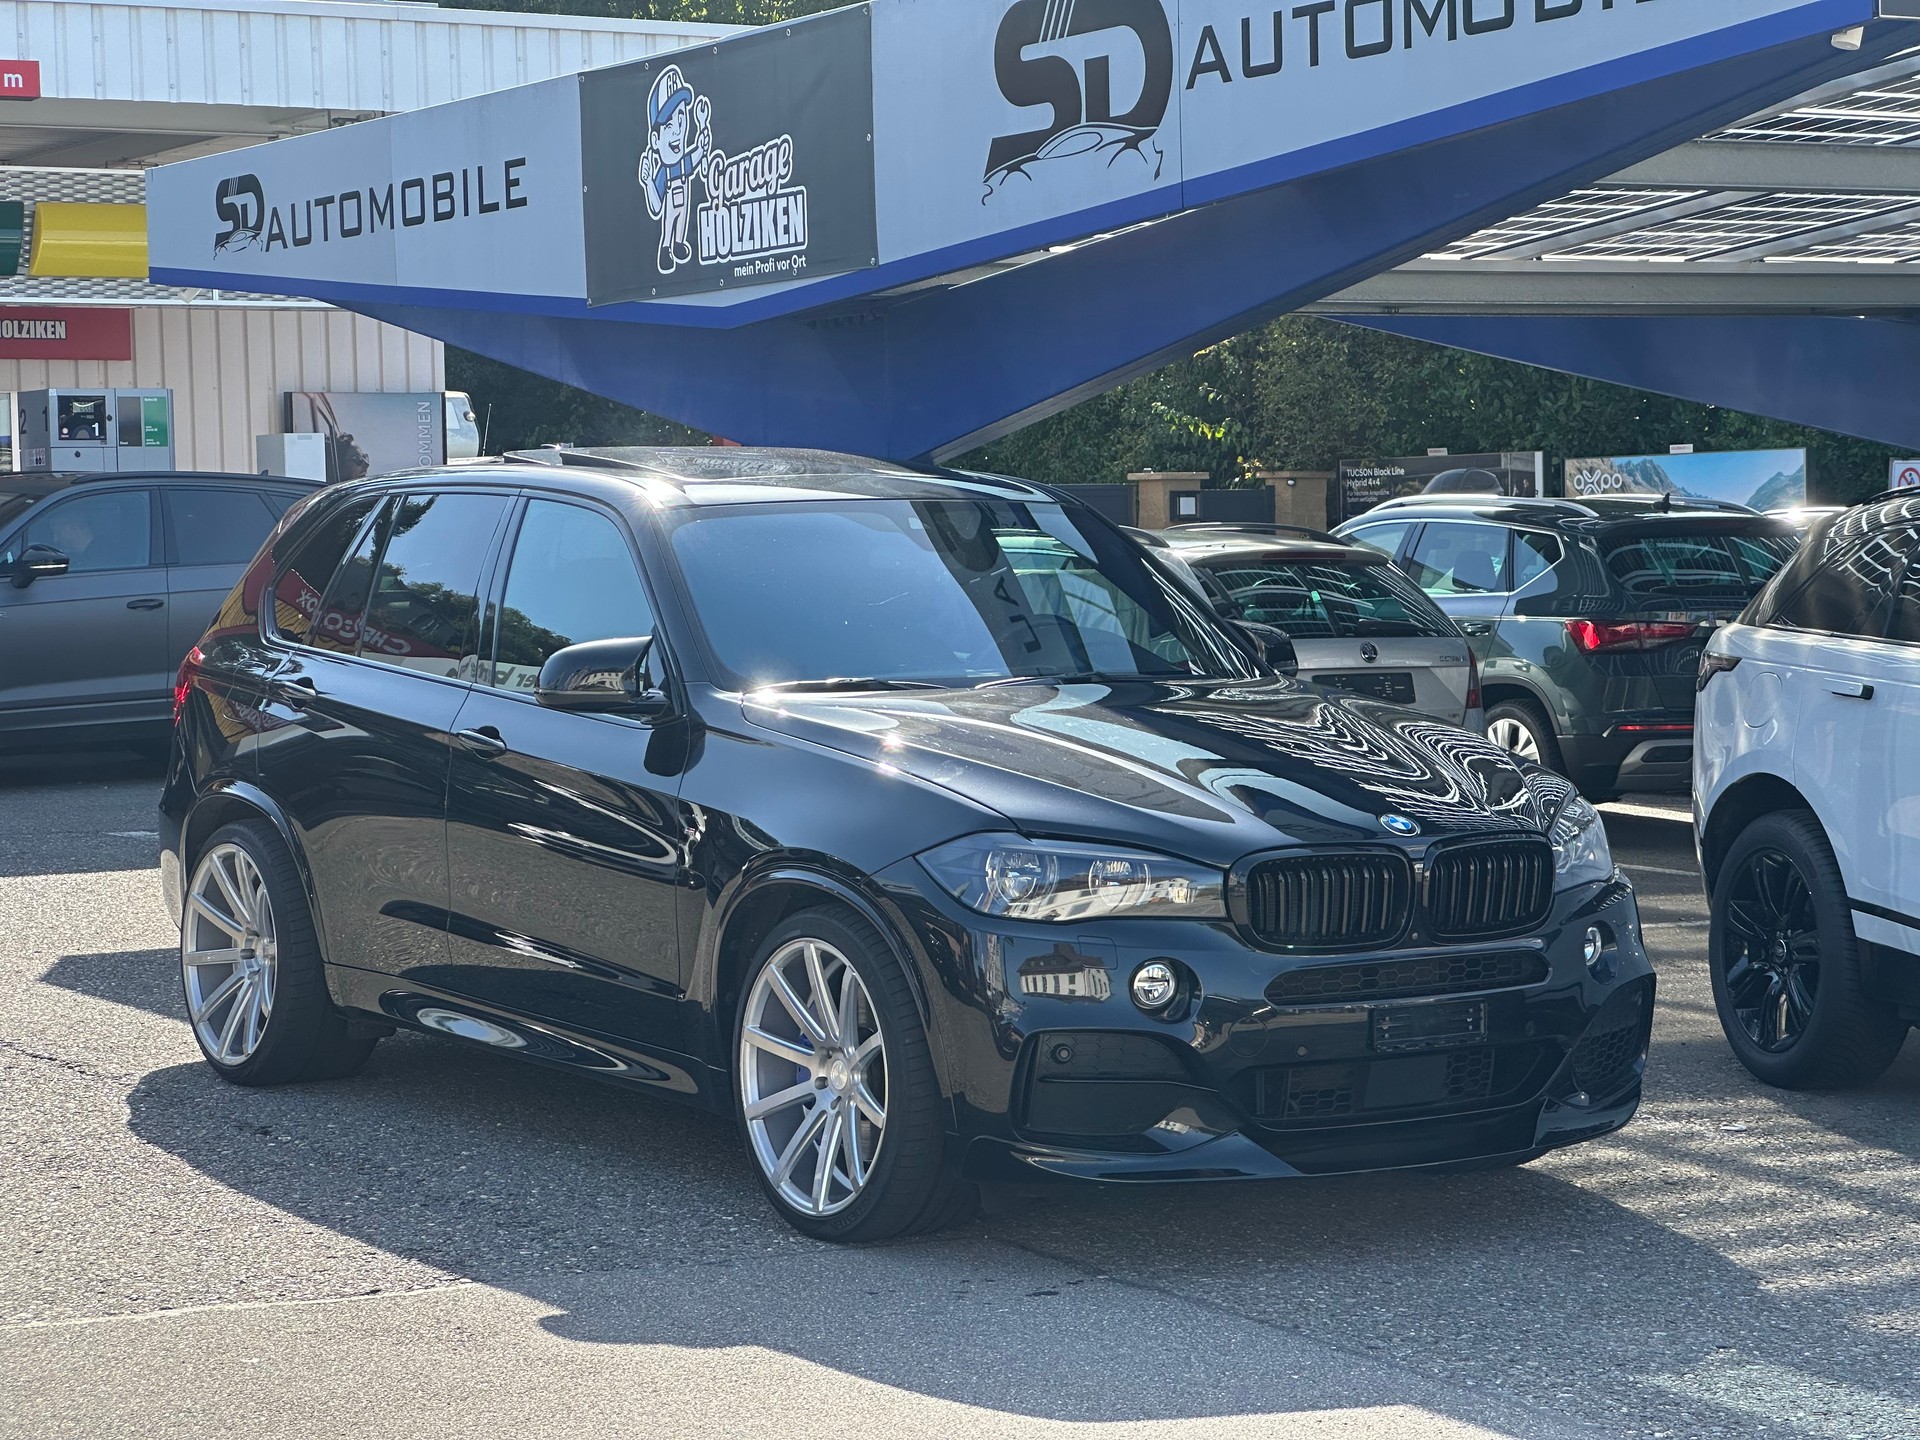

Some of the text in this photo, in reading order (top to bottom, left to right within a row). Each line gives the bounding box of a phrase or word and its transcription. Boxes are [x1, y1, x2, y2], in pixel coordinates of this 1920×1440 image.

[707, 141, 791, 212] Garage
[265, 157, 528, 252] AUTOMOBILE
[700, 193, 805, 258] HOLZIKEN
[734, 255, 807, 277] mein Profi vor Ort
[0, 319, 66, 339] OLZIKEN
[92, 422, 99, 436] 1
[1347, 466, 1405, 476] TUCSON Black Line
[1573, 469, 1622, 495] axpo
[1347, 479, 1367, 487] Hybrid
